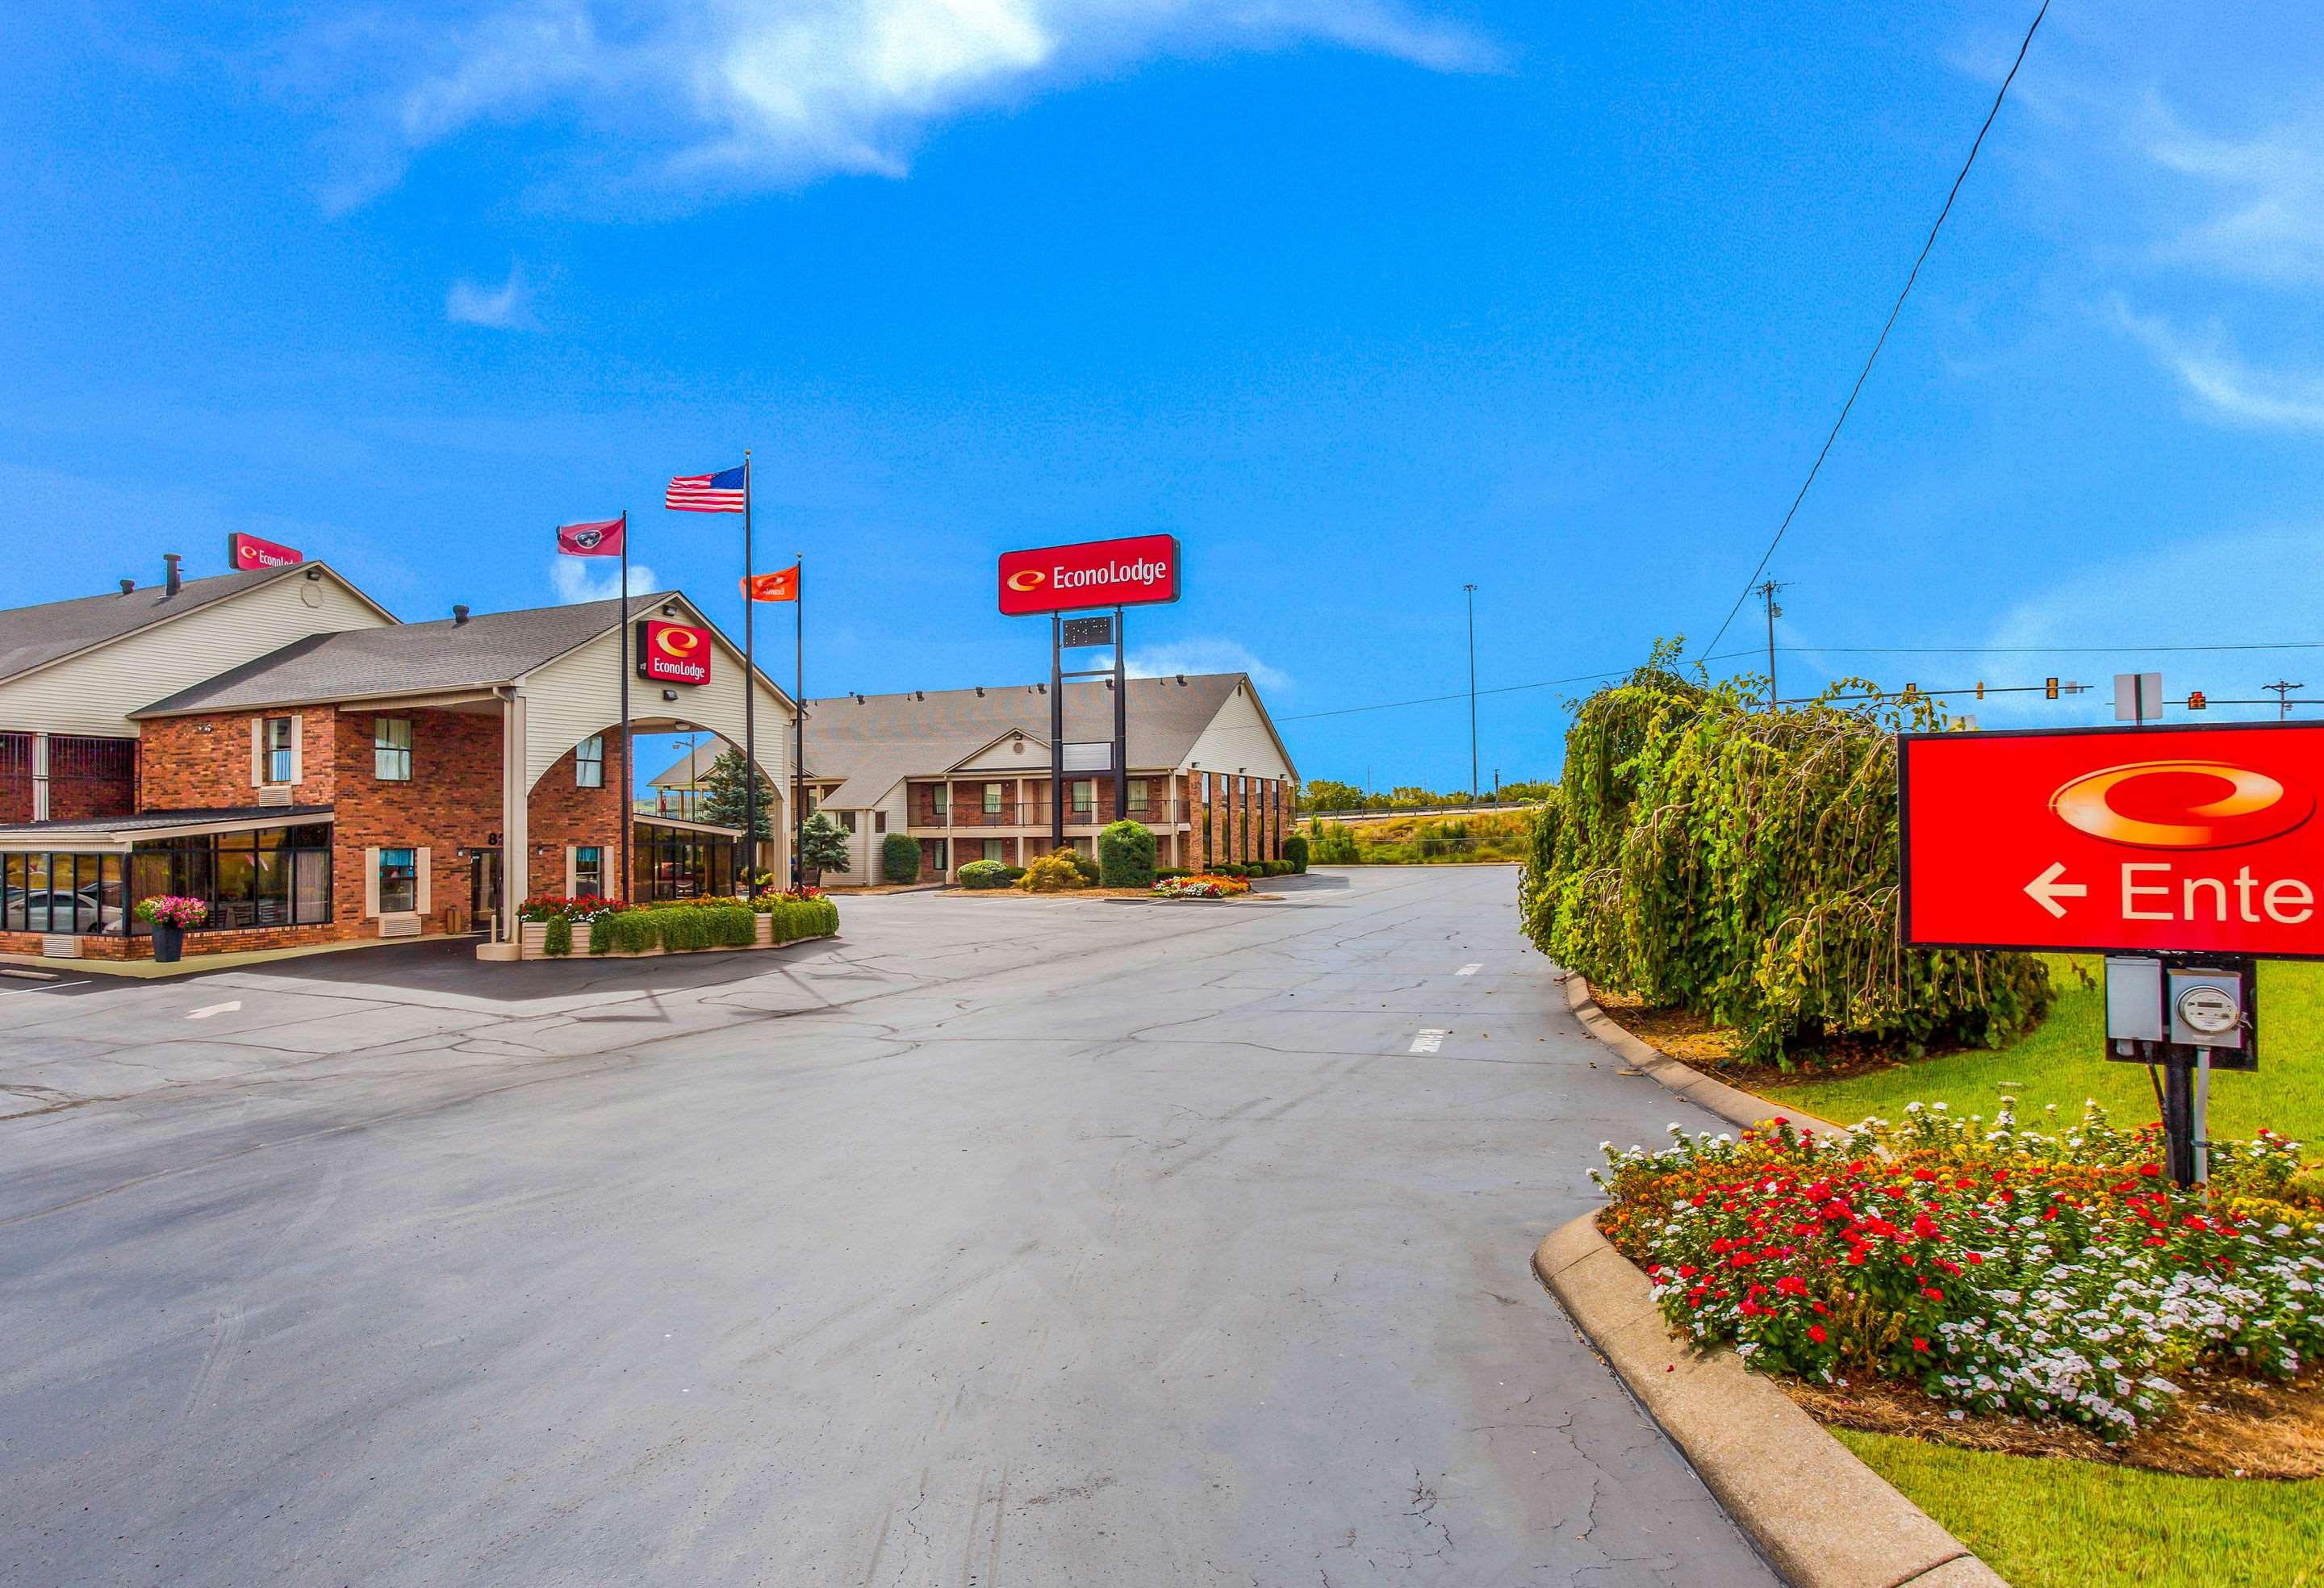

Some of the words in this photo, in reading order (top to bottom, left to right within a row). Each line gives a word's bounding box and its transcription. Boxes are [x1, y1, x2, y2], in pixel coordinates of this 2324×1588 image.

[1054, 558, 1167, 589] EconoLodge
[654, 658, 704, 680] EconoLodge
[2121, 863, 2314, 924] Ente
